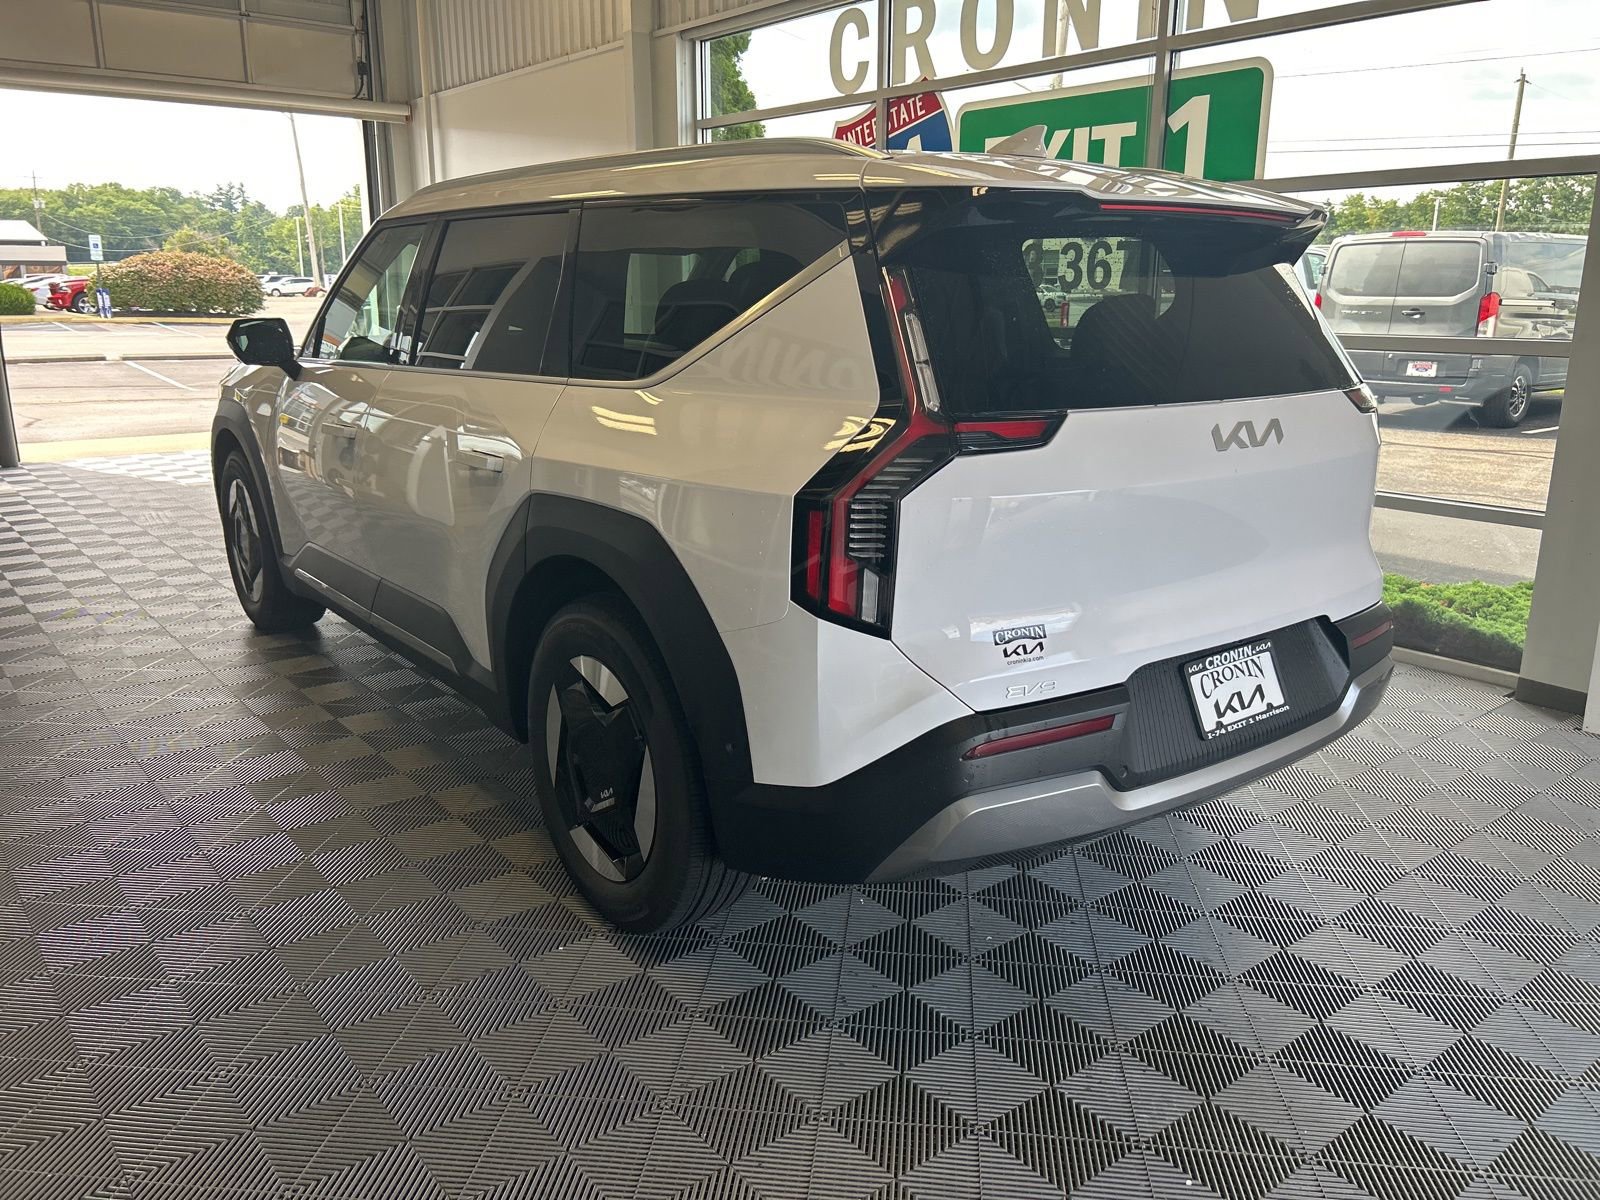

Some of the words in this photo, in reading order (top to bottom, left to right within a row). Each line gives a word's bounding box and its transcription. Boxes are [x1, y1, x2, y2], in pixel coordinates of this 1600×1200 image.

[830, 0, 1259, 96] CRON
[842, 94, 926, 146] NTERTATE
[1167, 94, 1211, 180] 1
[1211, 418, 1284, 452] KIA
[995, 625, 1045, 644] CRONIN
[1003, 641, 1044, 658] KIA
[1007, 655, 1044, 665] croninkia.com
[1200, 656, 1266, 699] CRONIN
[1006, 680, 1056, 699] EV9
[1213, 684, 1266, 719] KIA
[1207, 728, 1226, 740] I-74
[1227, 720, 1247, 732] EXIT
[1255, 704, 1290, 720] Harrison
